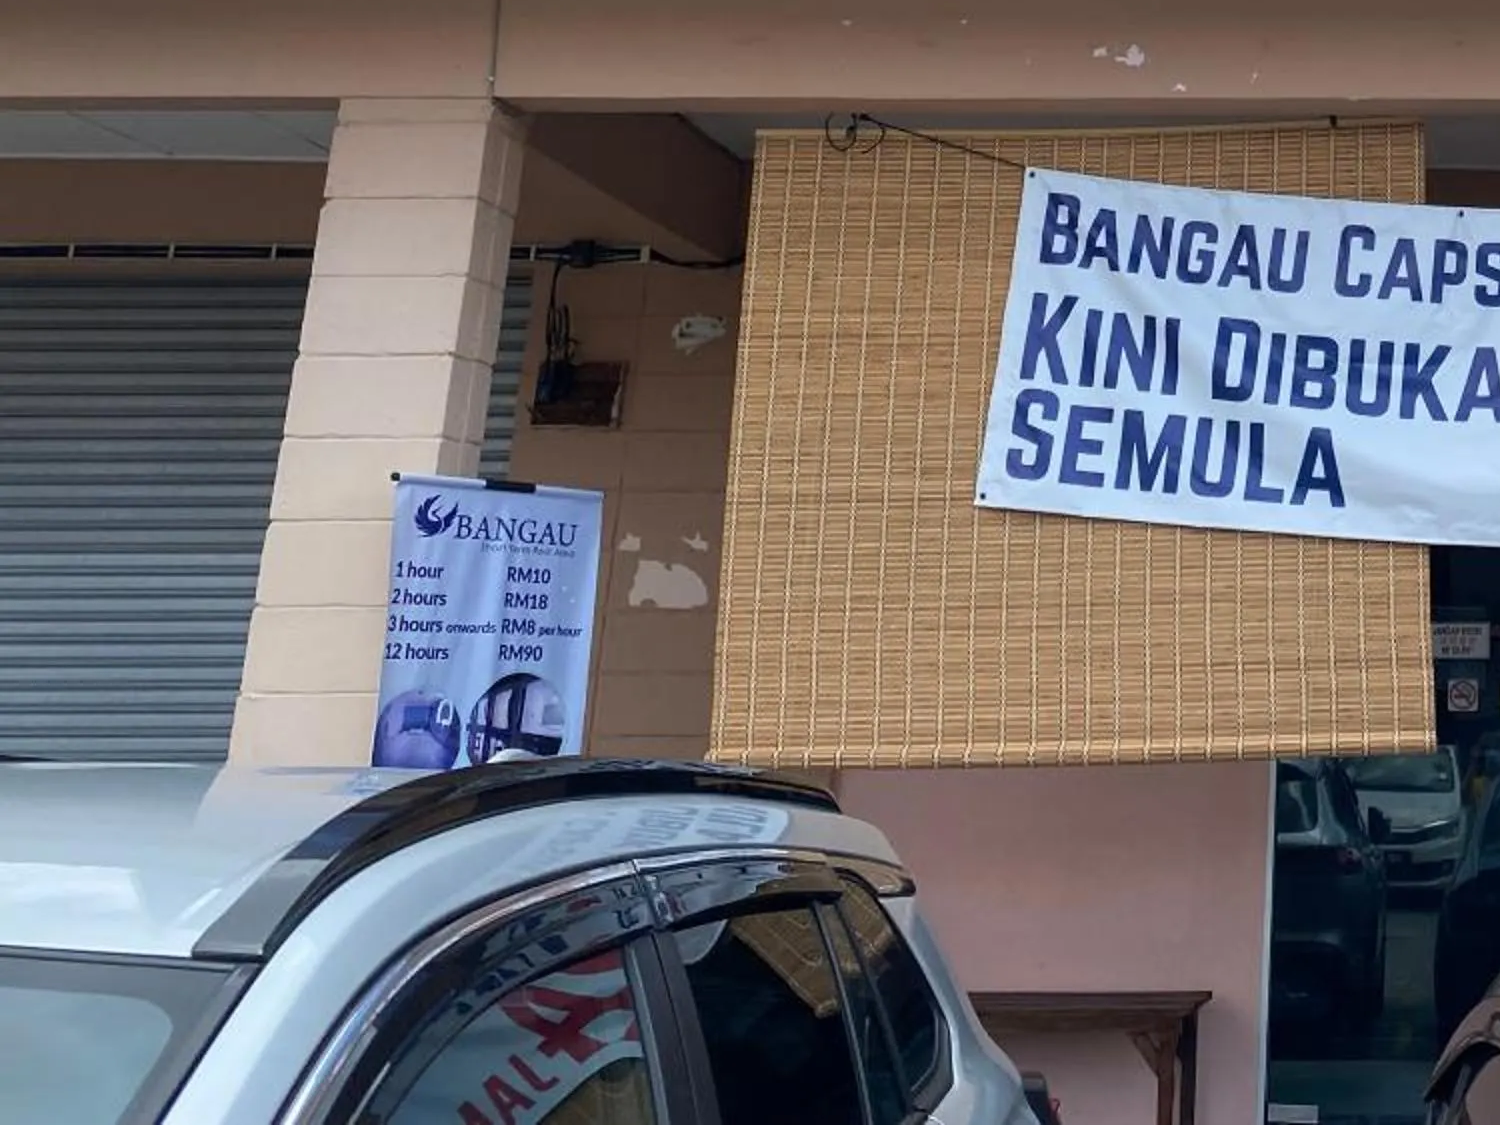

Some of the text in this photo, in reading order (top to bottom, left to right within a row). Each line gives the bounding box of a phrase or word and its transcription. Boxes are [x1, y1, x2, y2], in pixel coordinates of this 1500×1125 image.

[1038, 191, 1312, 295] BANGAU
[1018, 291, 1181, 393] KINI
[1004, 386, 1348, 509] SEMULA
[454, 515, 578, 546] BANGAU
[396, 561, 551, 584] 1 hour RM10
[391, 588, 549, 609] 2 hours RM18
[387, 616, 397, 632] 3
[399, 616, 443, 633] hours
[445, 621, 496, 635] onwards
[501, 618, 535, 636] RM8
[554, 625, 582, 637] hour
[385, 643, 543, 662] 12 hours RM90
